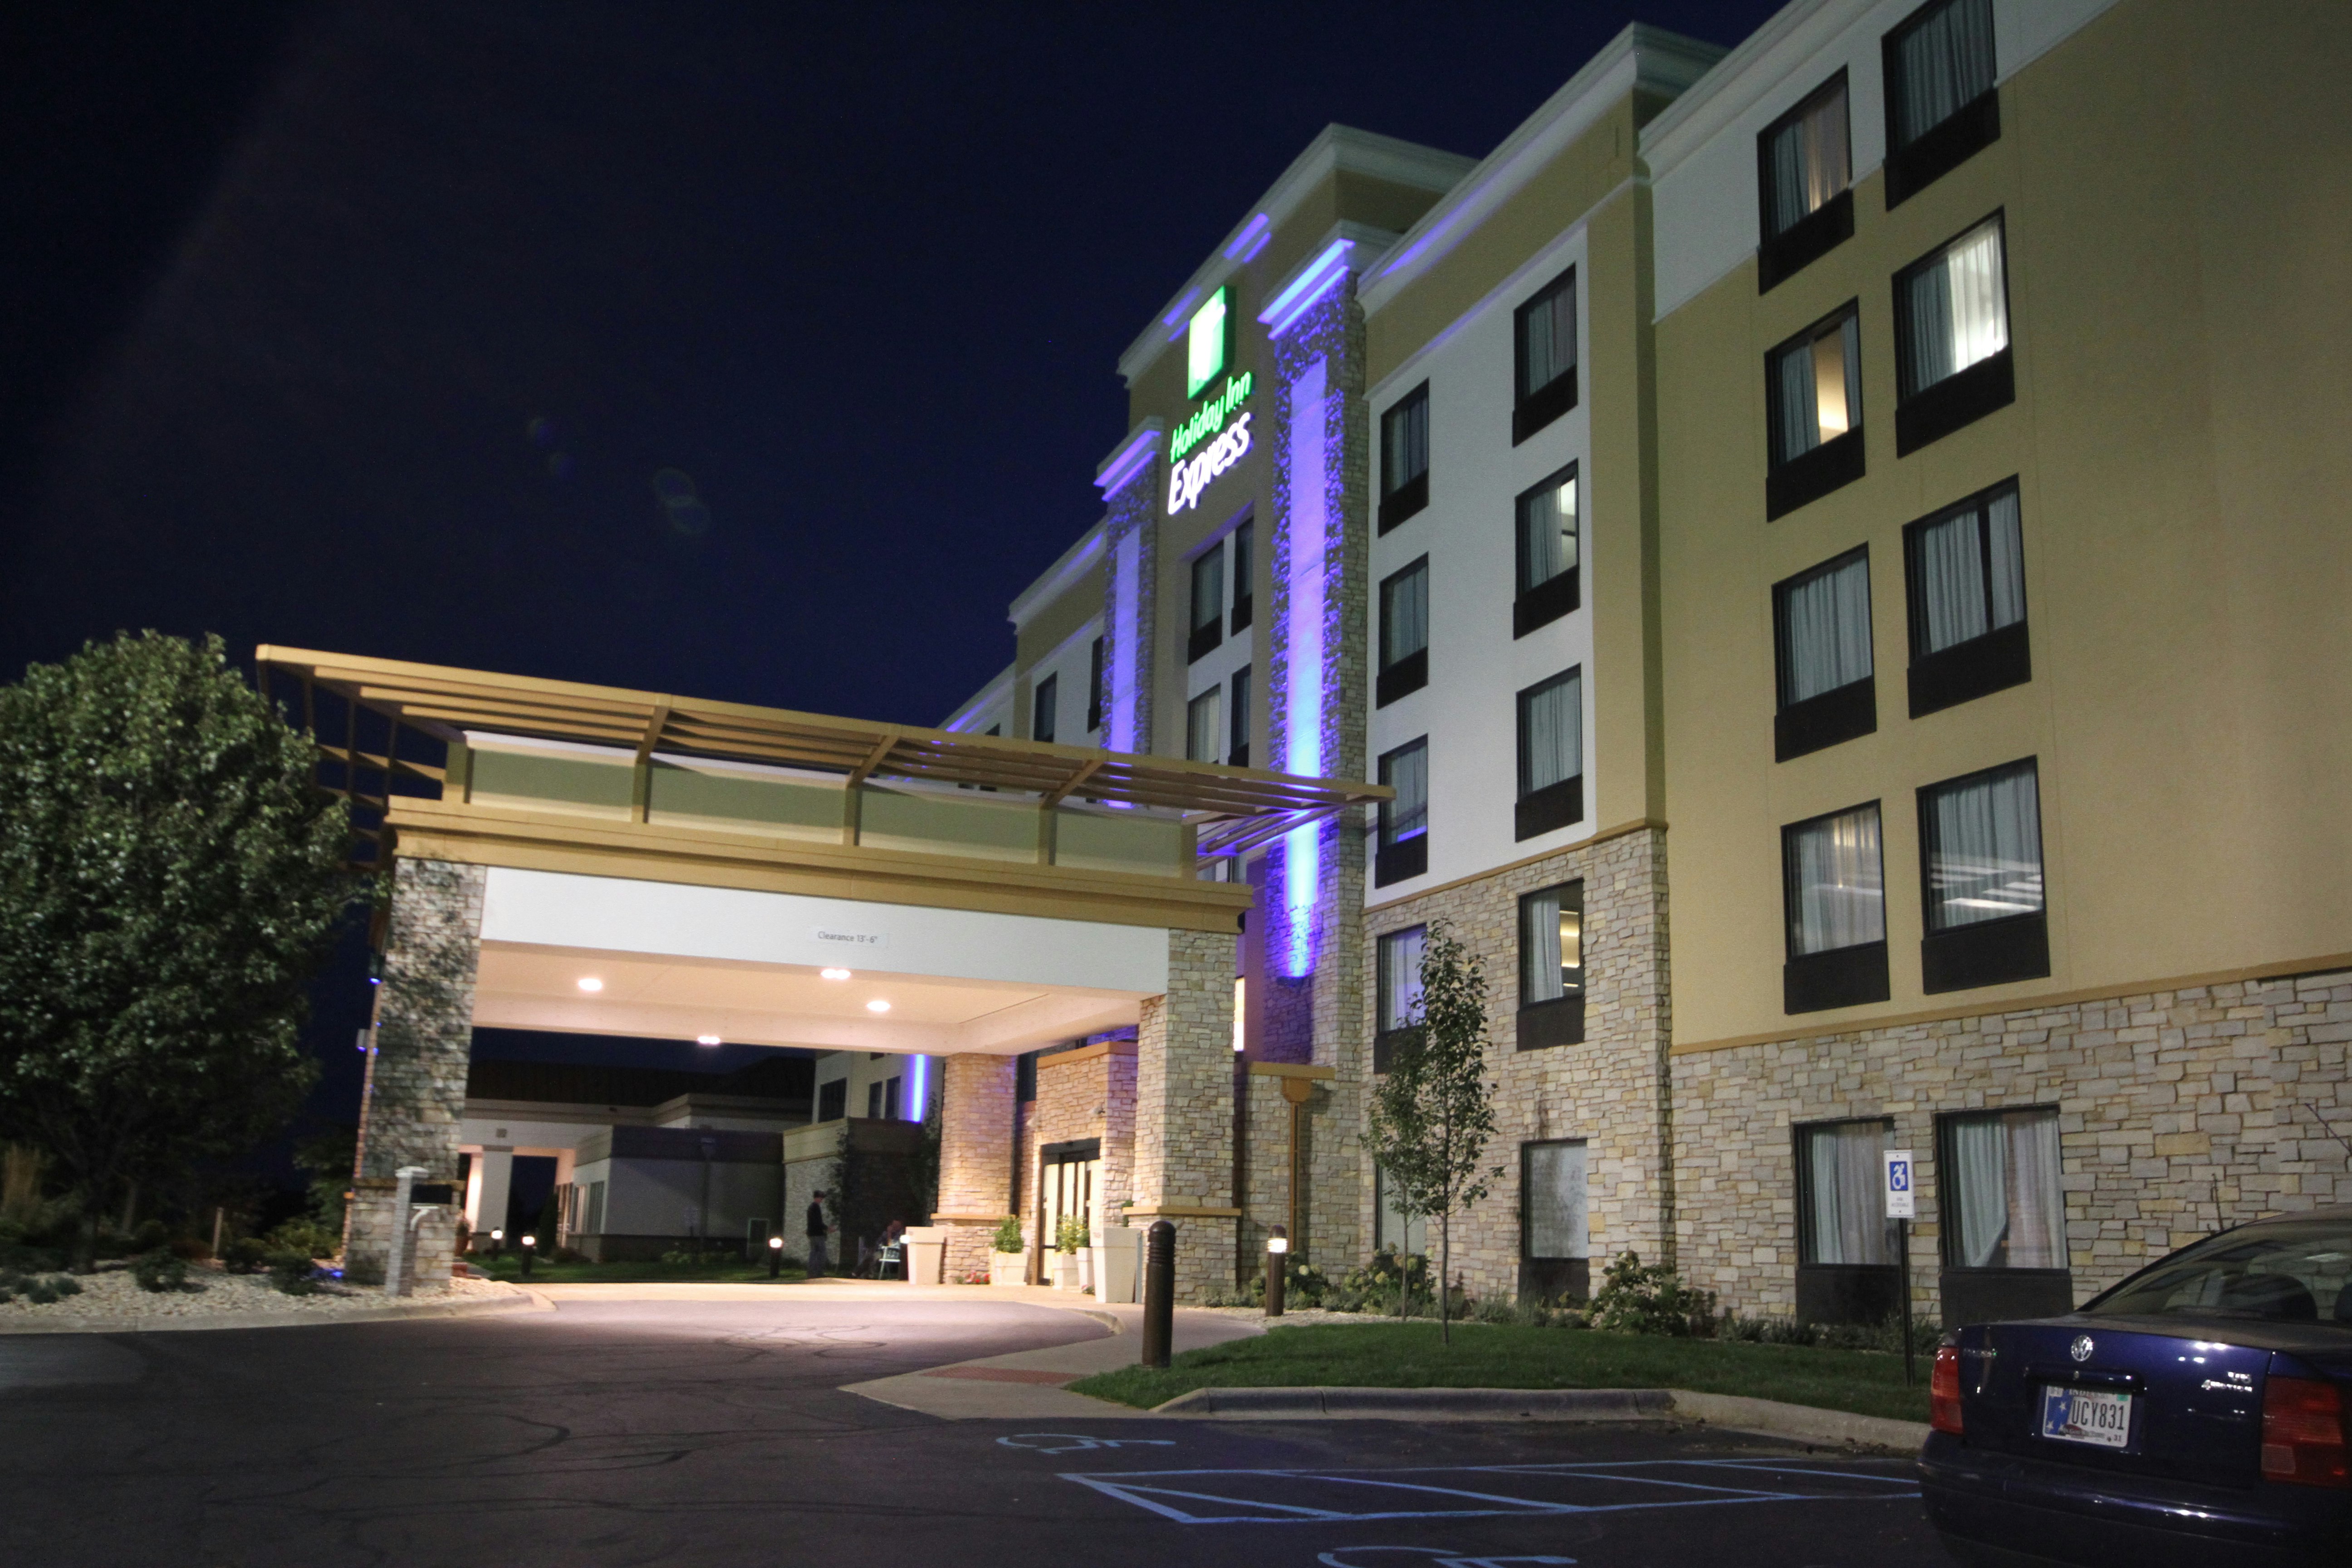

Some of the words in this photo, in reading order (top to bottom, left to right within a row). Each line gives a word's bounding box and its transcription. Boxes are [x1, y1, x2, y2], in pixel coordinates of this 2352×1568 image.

[1170, 395, 1225, 464] Holiday
[1225, 371, 1252, 413] Inn
[1168, 412, 1251, 515] Express
[818, 931, 854, 942] Clearance
[2072, 1400, 2124, 1430] UCY831
